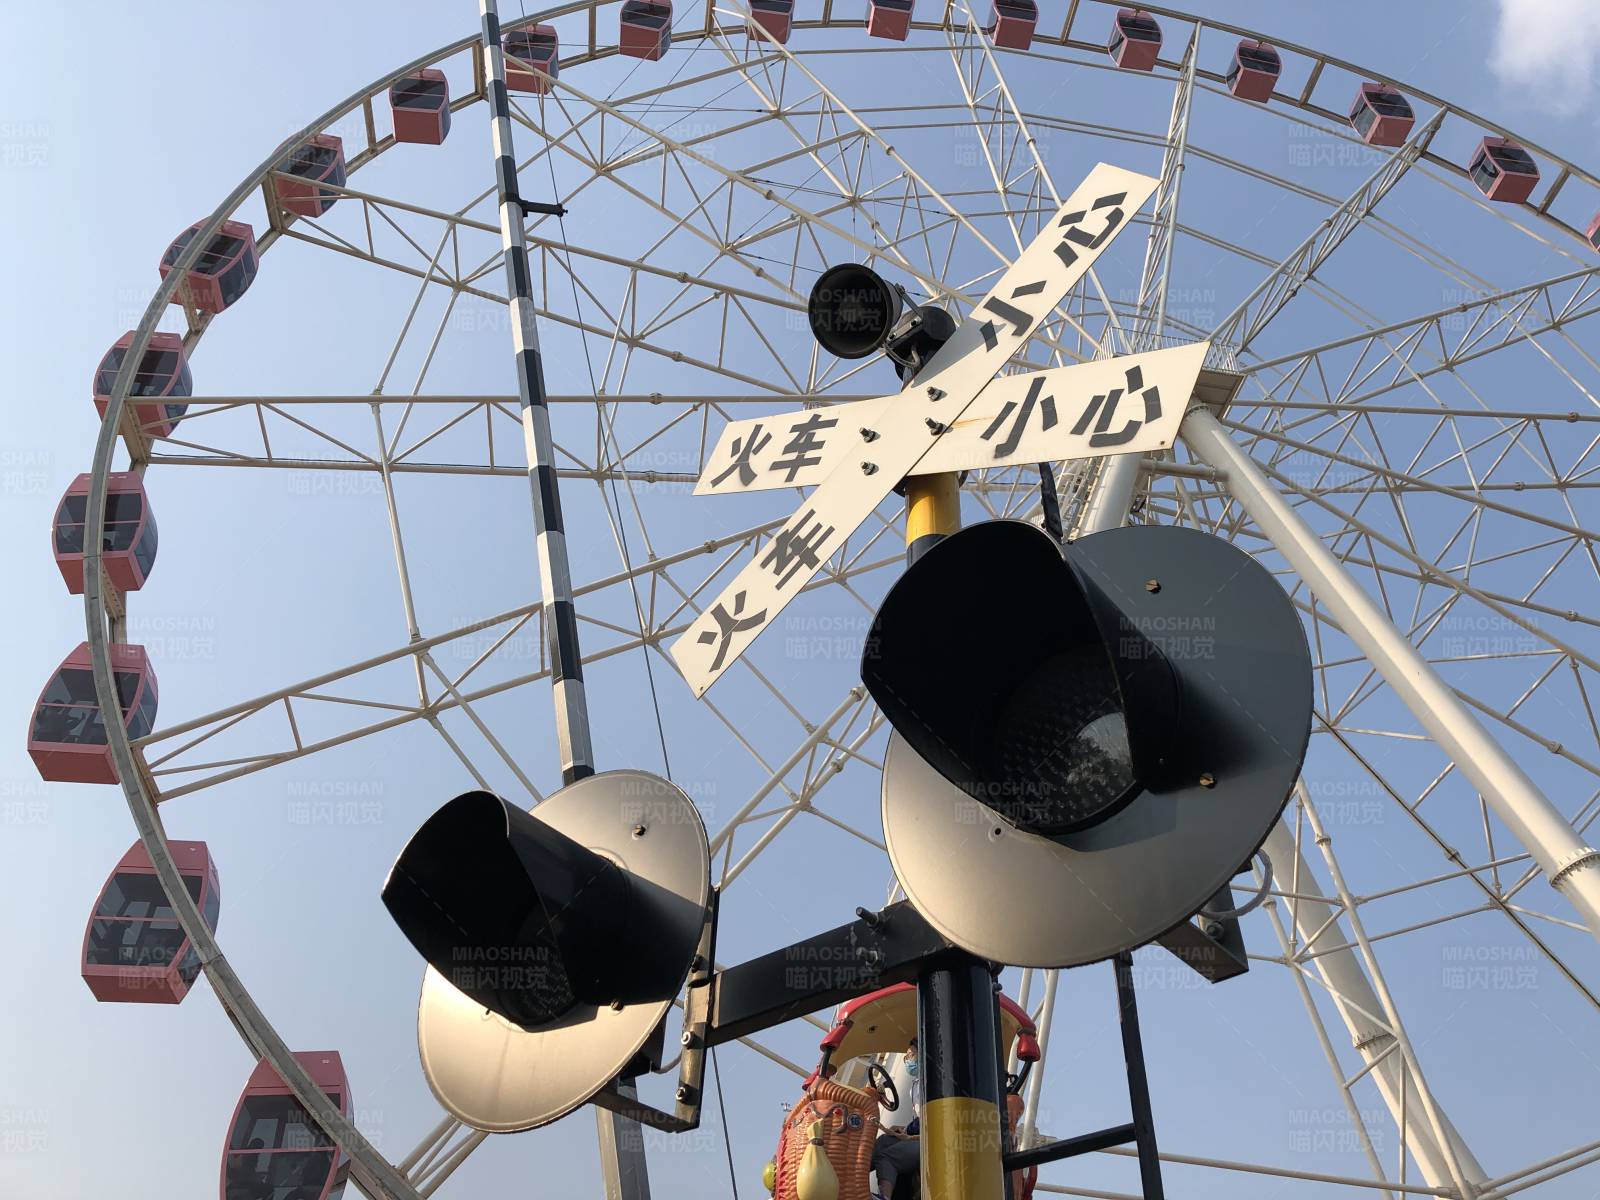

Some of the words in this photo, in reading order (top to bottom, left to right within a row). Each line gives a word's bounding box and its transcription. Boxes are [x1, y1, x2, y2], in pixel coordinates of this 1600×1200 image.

[698, 510, 834, 672] 火车
[979, 192, 1127, 352] 小心
[711, 414, 838, 487] 火车
[981, 366, 1161, 458] 小心
